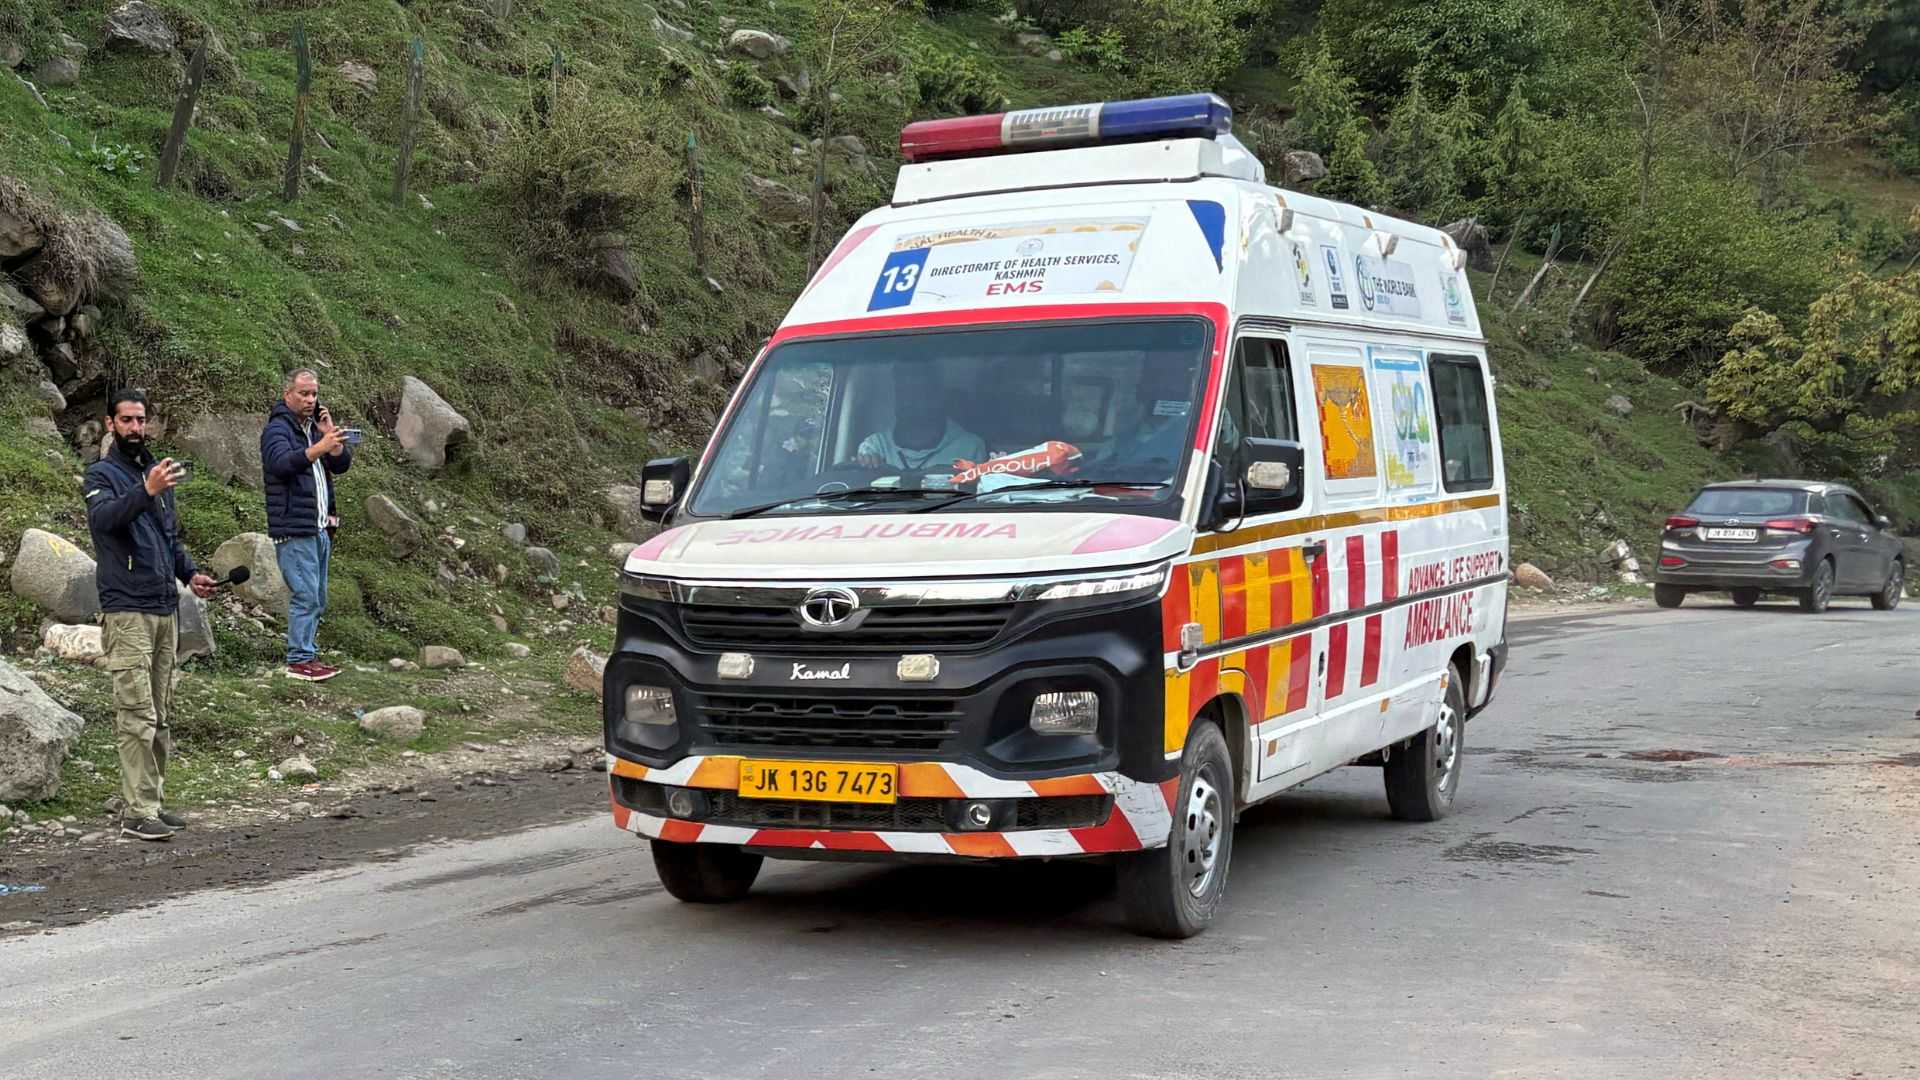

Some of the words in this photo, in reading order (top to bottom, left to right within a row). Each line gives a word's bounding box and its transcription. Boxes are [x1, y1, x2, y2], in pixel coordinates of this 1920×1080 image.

[930, 260, 1001, 277] DIRECTORATE
[1004, 259, 1018, 270] OF
[1021, 256, 1061, 268] HEALTH
[1064, 254, 1120, 266] SERVICES,
[995, 268, 1046, 281] KASHMIR
[883, 263, 919, 293] 13
[986, 280, 1044, 296] EMS
[1408, 561, 1445, 595] ADVANCE
[1448, 556, 1464, 585] LIFE
[1466, 550, 1498, 580] SUPPORT
[1404, 591, 1474, 652] AMBULANCE
[790, 662, 850, 682] Kamal
[755, 769, 778, 792] JK
[790, 769, 827, 793] 13G
[837, 771, 893, 795] 7473
